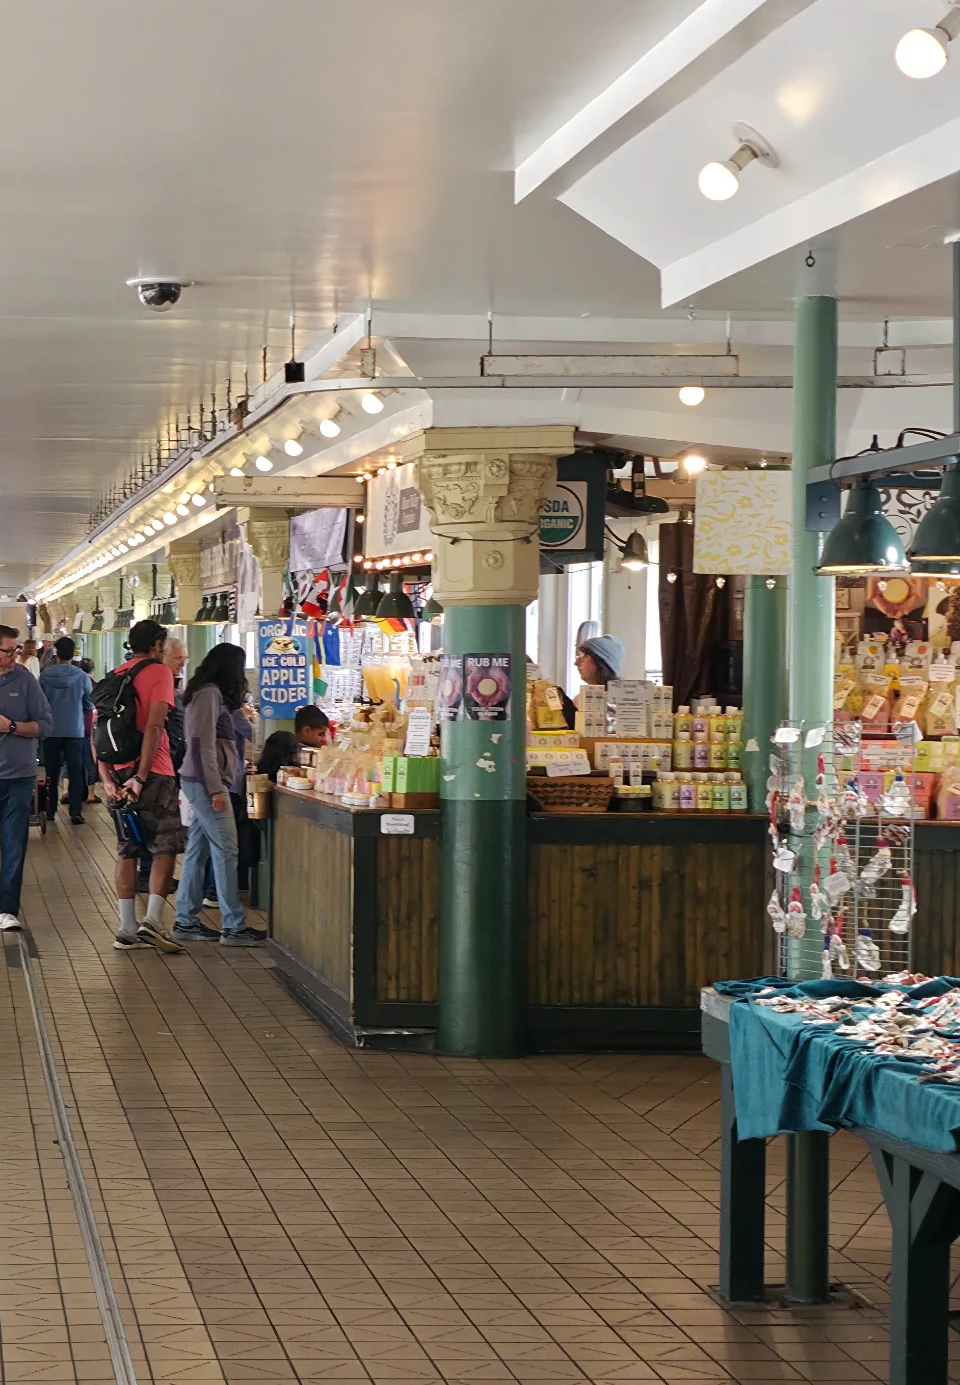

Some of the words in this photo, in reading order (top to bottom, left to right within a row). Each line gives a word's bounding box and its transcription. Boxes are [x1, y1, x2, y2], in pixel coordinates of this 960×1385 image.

[262, 656, 280, 667] ICE
[280, 655, 306, 667] COLD
[467, 657, 490, 667] RUB
[492, 657, 510, 667] ME
[261, 669, 306, 686] APPLE
[261, 687, 307, 704] CIDER
